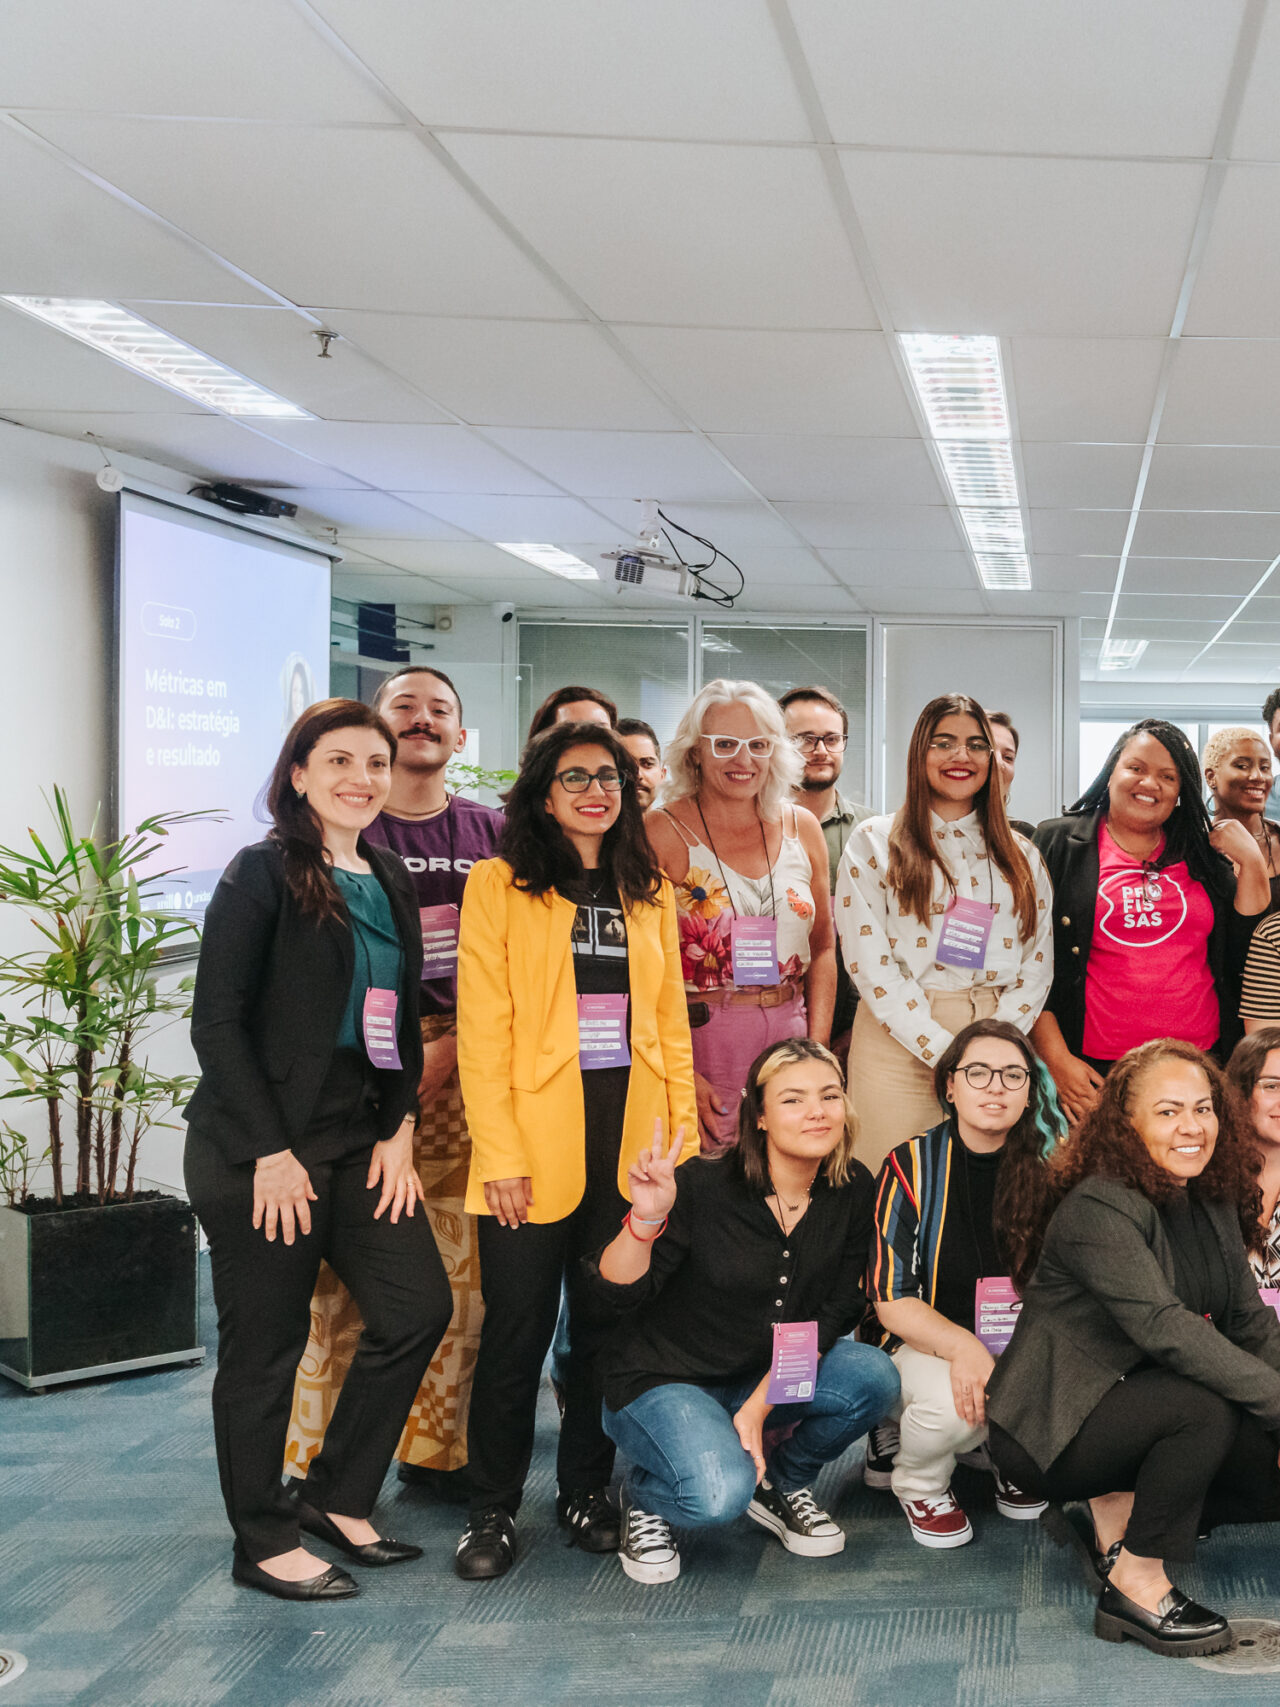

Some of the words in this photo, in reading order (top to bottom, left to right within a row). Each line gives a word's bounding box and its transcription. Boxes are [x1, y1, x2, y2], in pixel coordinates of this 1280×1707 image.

[175, 616, 181, 630] 2
[145, 667, 204, 697] Métricas
[206, 679, 228, 698] em
[145, 705, 175, 731] D&I:
[177, 709, 240, 738] estratégia
[145, 747, 154, 766] e
[157, 741, 221, 767] resultado
[400, 856, 474, 874] ORO
[1123, 899, 1155, 913] FIS
[1123, 912, 1163, 928] SAS
